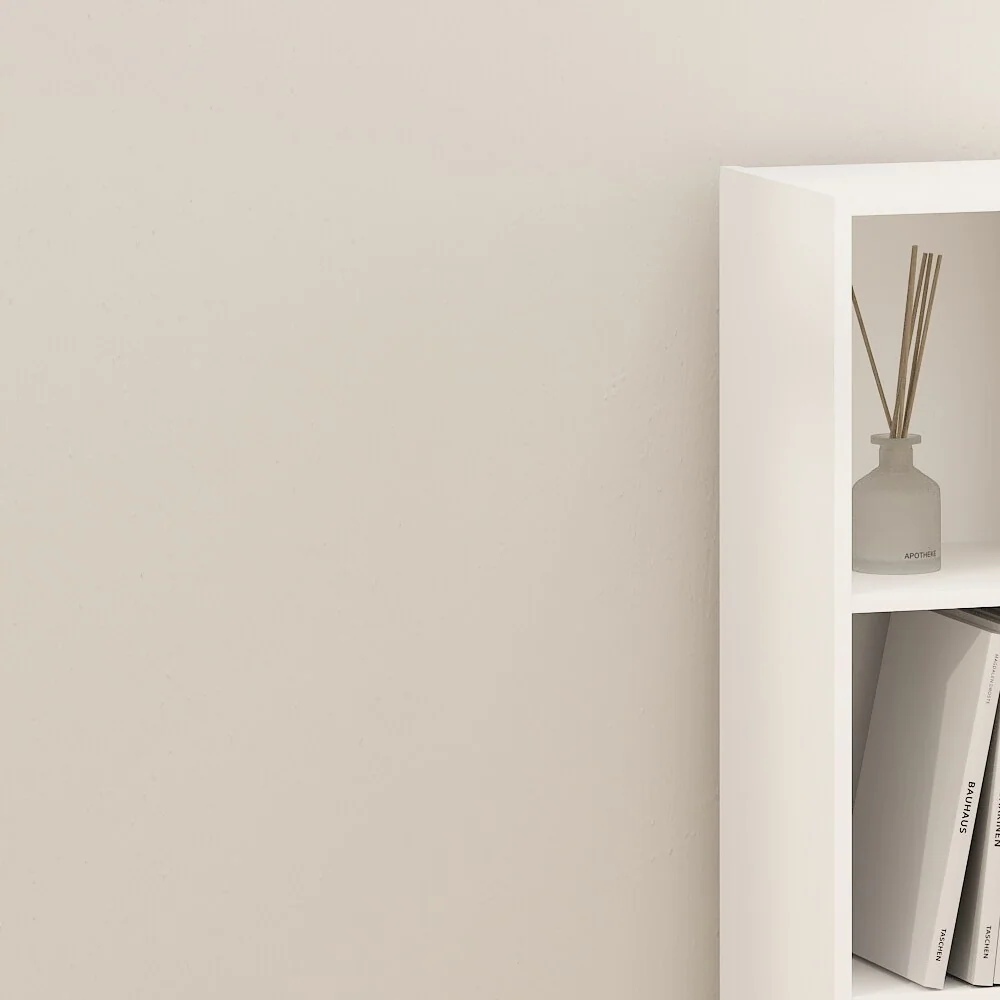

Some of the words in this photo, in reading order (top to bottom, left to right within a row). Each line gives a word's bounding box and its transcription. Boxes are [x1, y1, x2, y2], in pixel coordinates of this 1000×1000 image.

[959, 781, 976, 834] BAUHAUS
[936, 929, 947, 962] TASCHEN
[983, 926, 992, 959] TASCHEN
